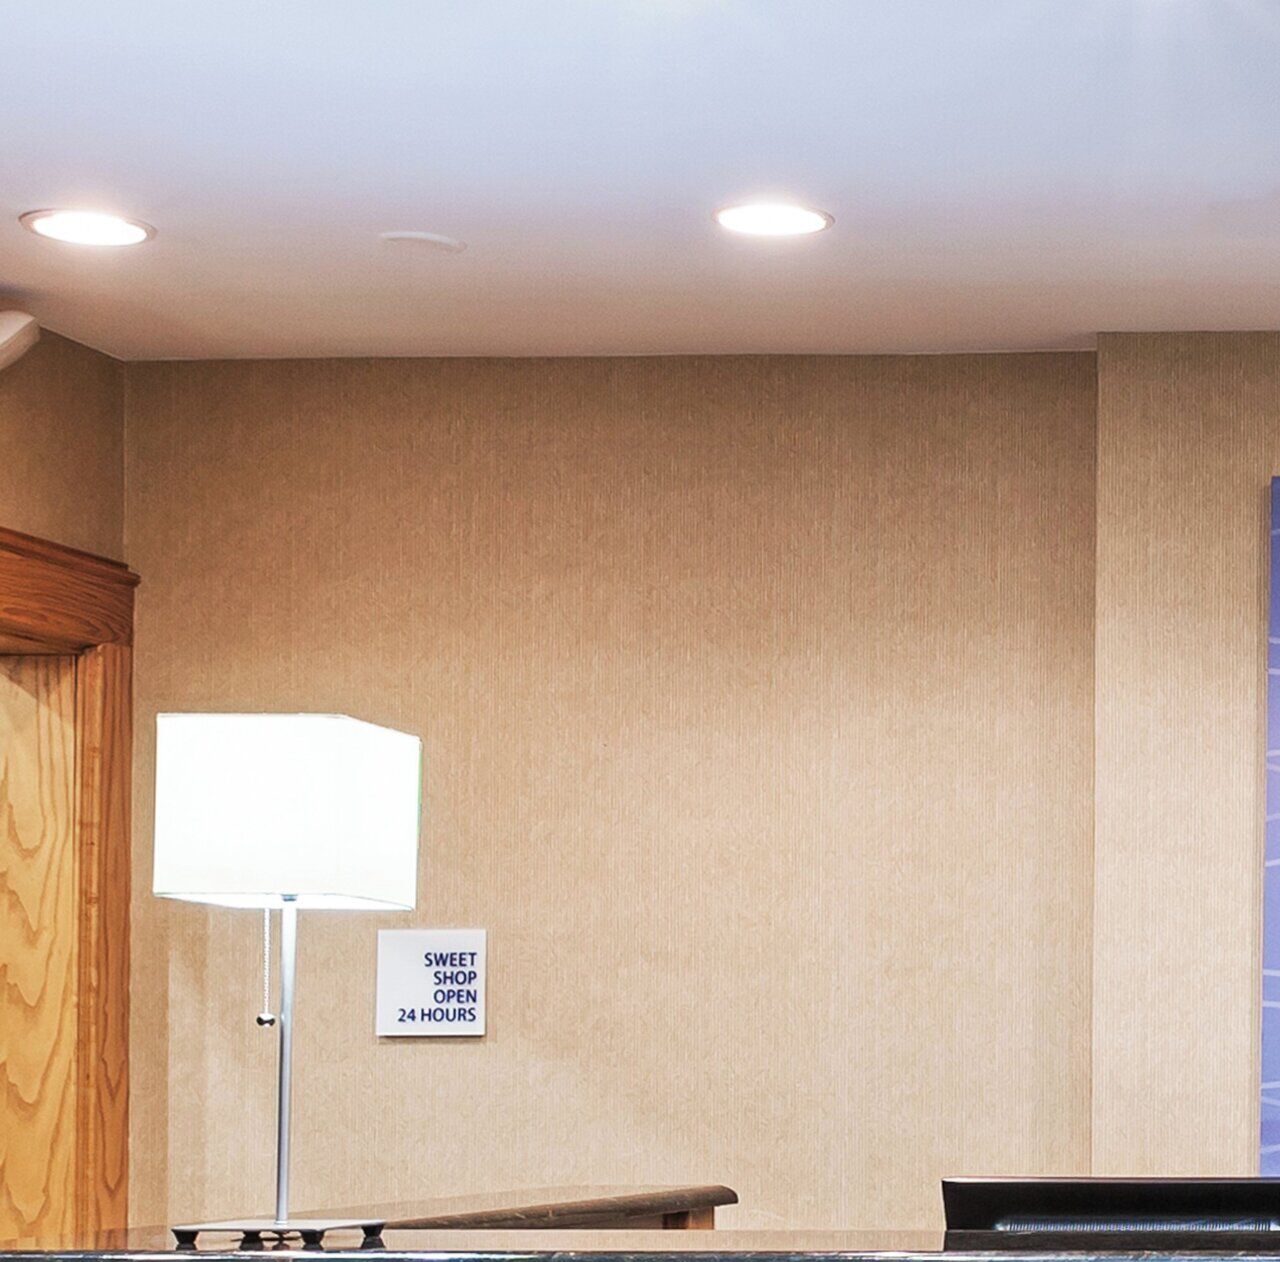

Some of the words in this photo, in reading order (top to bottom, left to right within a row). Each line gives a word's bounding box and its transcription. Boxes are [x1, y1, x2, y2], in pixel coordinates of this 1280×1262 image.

[424, 952, 477, 967] SWEET
[433, 970, 477, 985] SHOP
[433, 988, 477, 1004] OPEN
[398, 1008, 416, 1022] 24
[420, 1007, 477, 1022] HOURS
